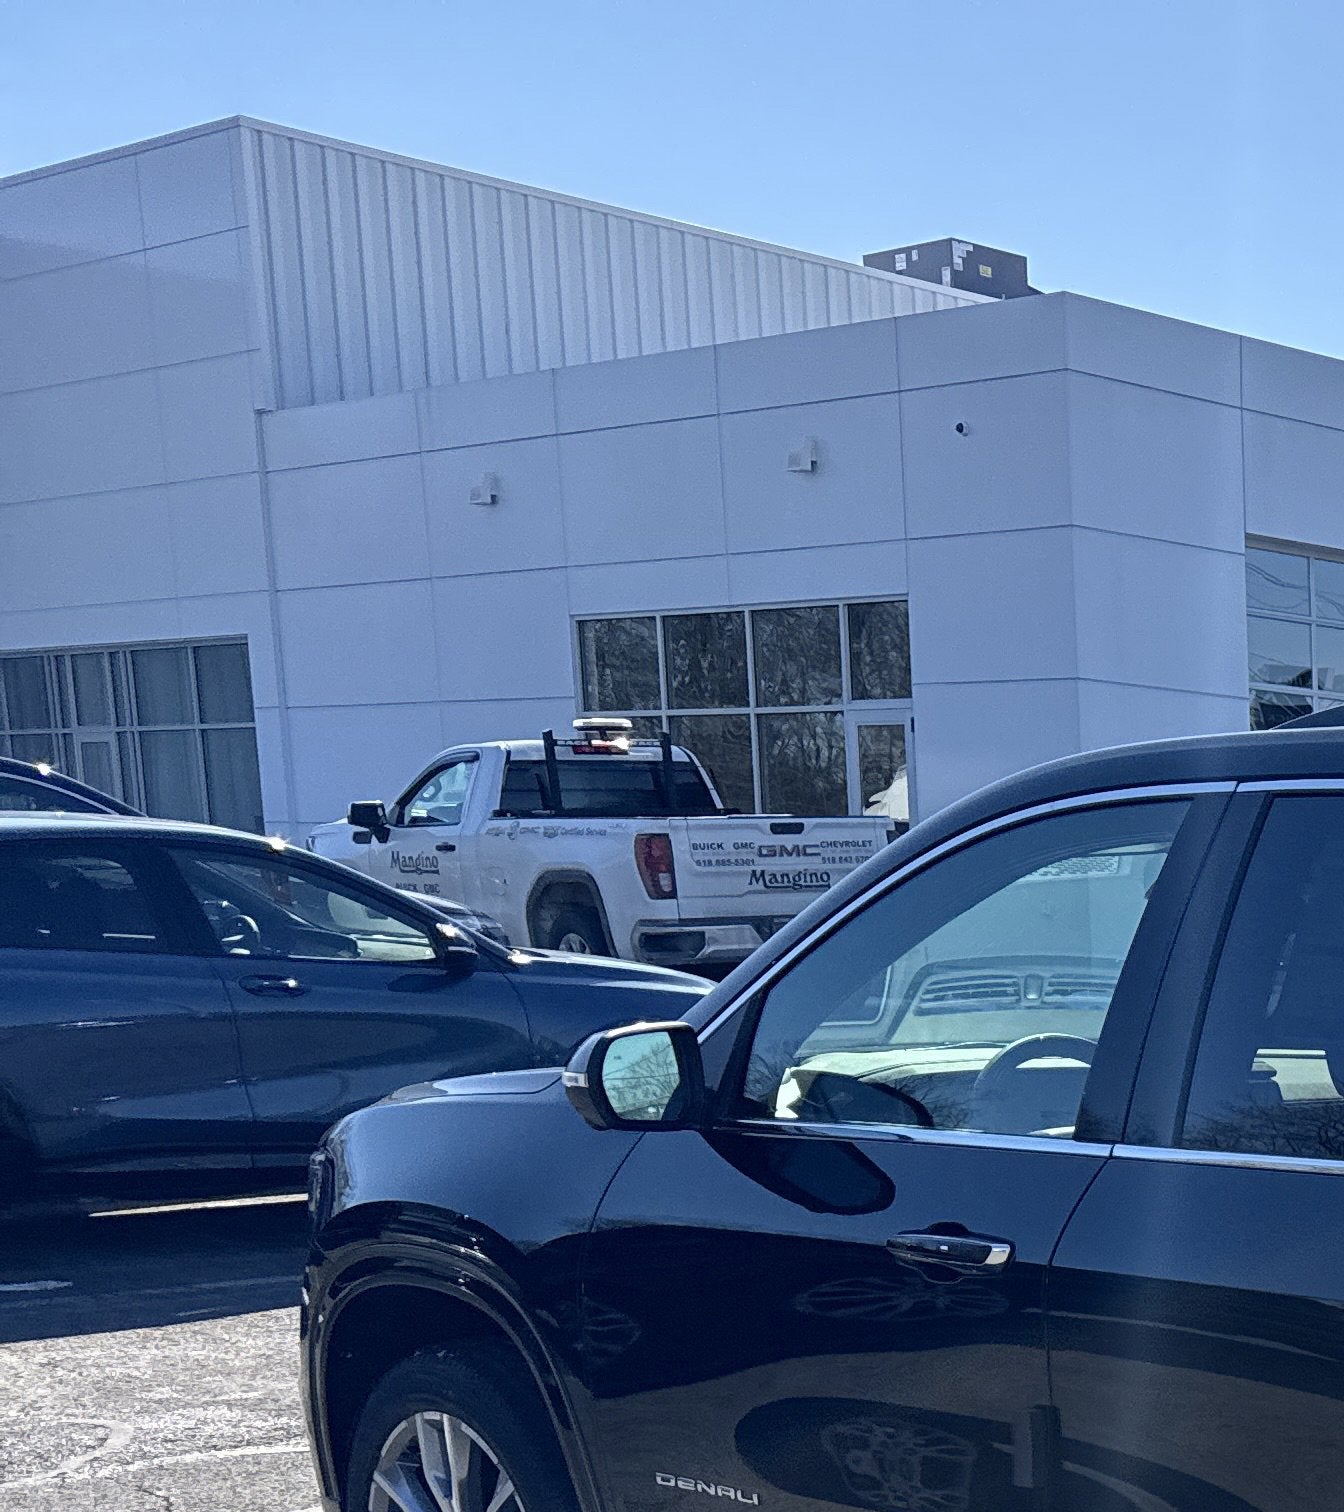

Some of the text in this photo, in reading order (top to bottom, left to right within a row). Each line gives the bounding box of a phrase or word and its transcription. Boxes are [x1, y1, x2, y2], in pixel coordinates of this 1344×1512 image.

[691, 841, 724, 850] BUICK
[757, 843, 821, 858] GMC
[820, 839, 873, 849] CHEVROLET
[390, 851, 440, 875] Mangino
[748, 868, 831, 890] Mangino
[655, 1471, 759, 1506] DENALI
